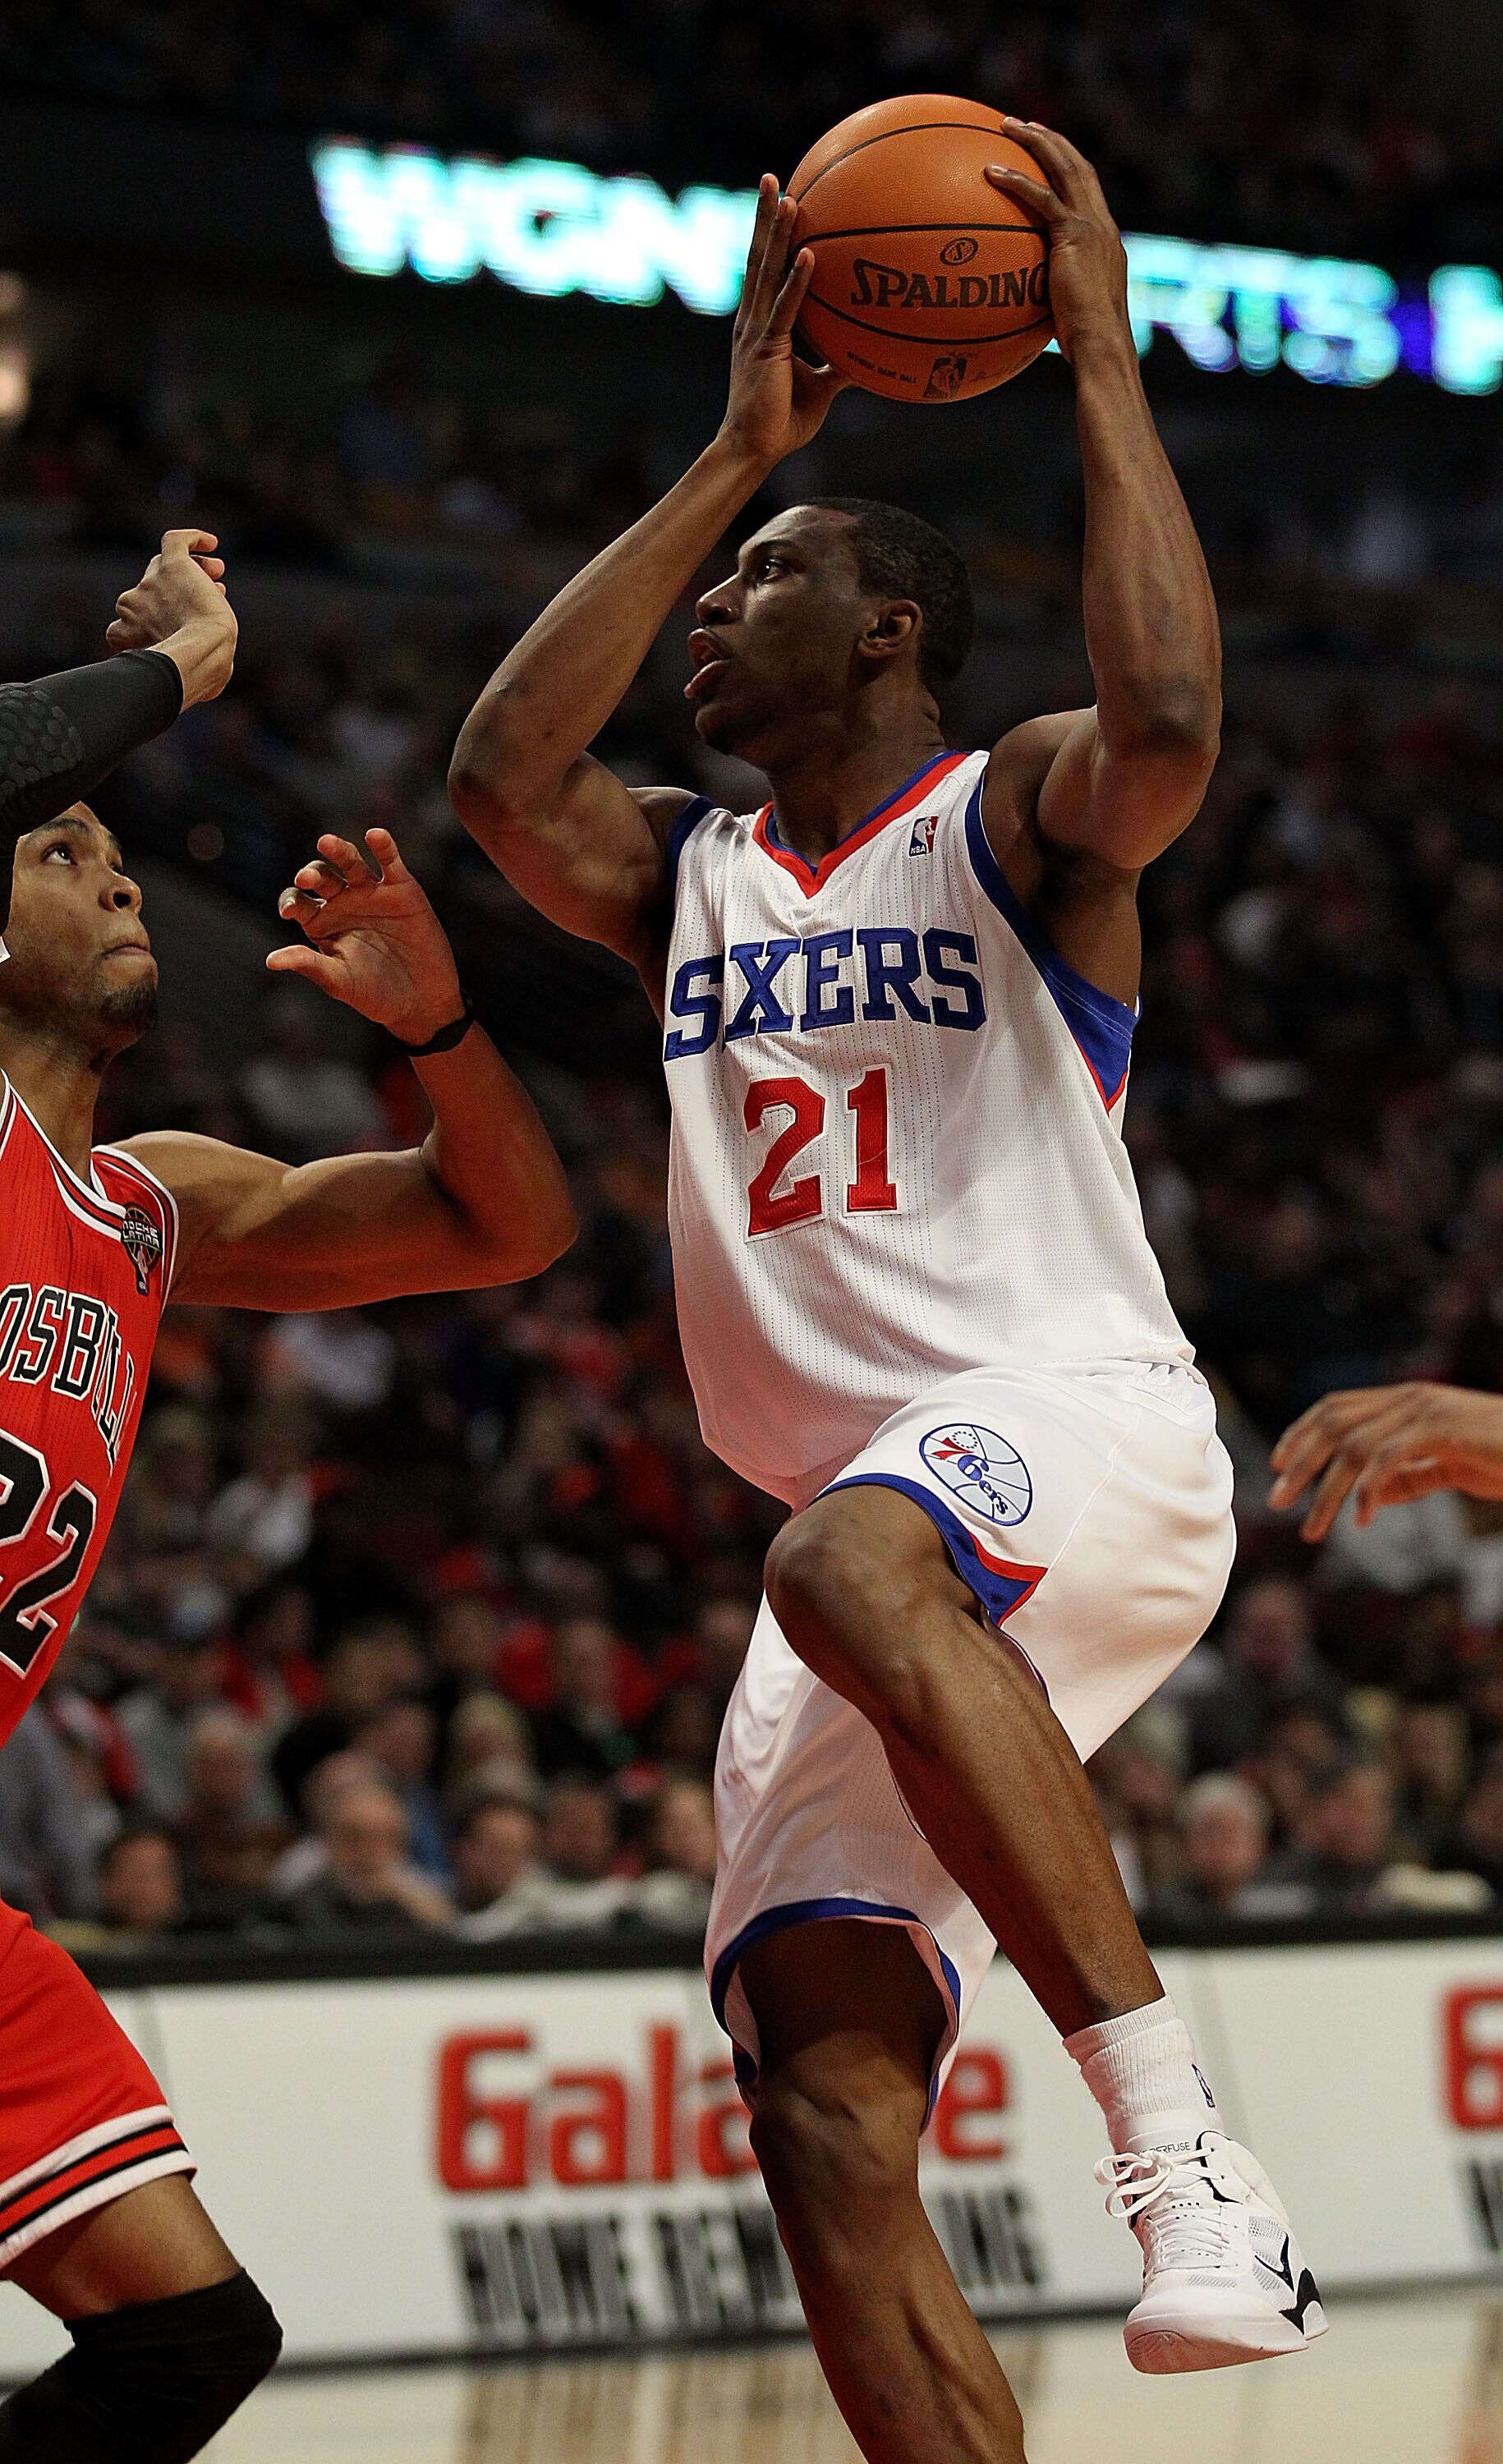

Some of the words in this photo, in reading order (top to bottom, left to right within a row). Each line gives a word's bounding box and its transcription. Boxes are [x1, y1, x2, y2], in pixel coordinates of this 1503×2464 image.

[910, 844, 926, 855] NBA
[742, 1063, 903, 1243] 21
[122, 1220, 159, 1239] NOCHE
[122, 1230, 160, 1249] LATINA
[437, 2022, 1007, 2191] Galae
